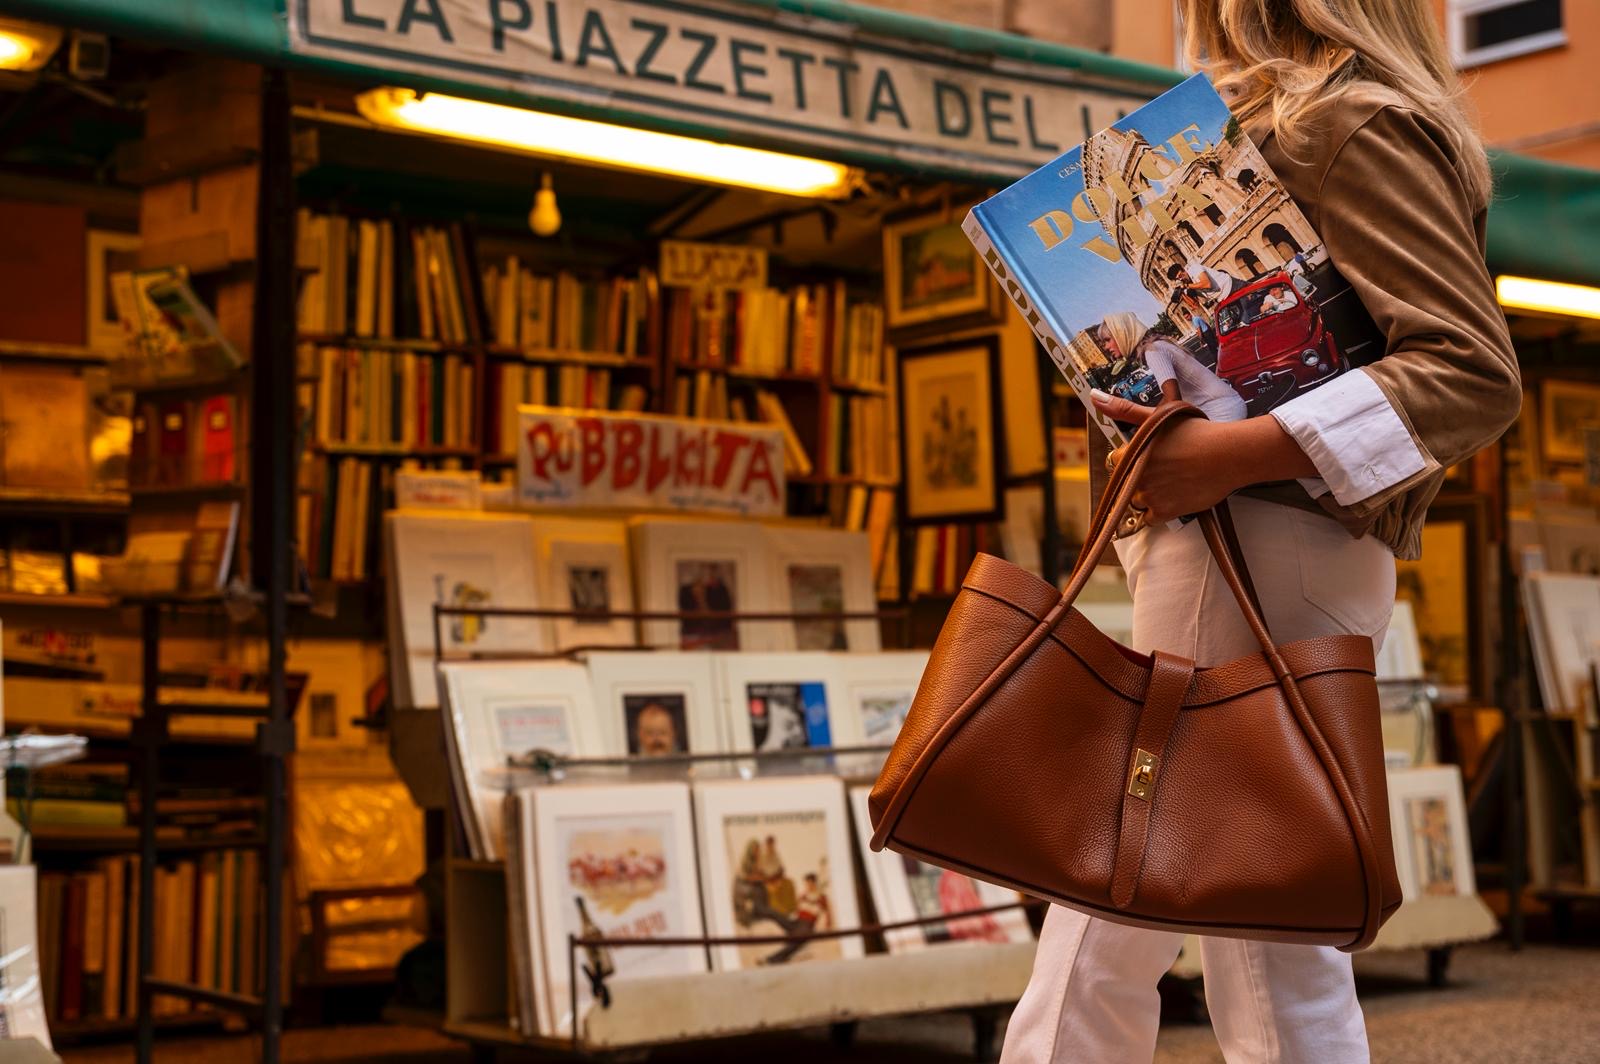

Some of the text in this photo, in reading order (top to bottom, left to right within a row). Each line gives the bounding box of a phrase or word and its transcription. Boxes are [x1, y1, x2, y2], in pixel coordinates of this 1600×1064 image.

[486, 0, 911, 130] PIAZZETTA
[932, 78, 1060, 153] DEL
[1027, 122, 1213, 253] DOLCE
[1080, 183, 1215, 265] VITA
[984, 246, 1086, 395] DOLCE
